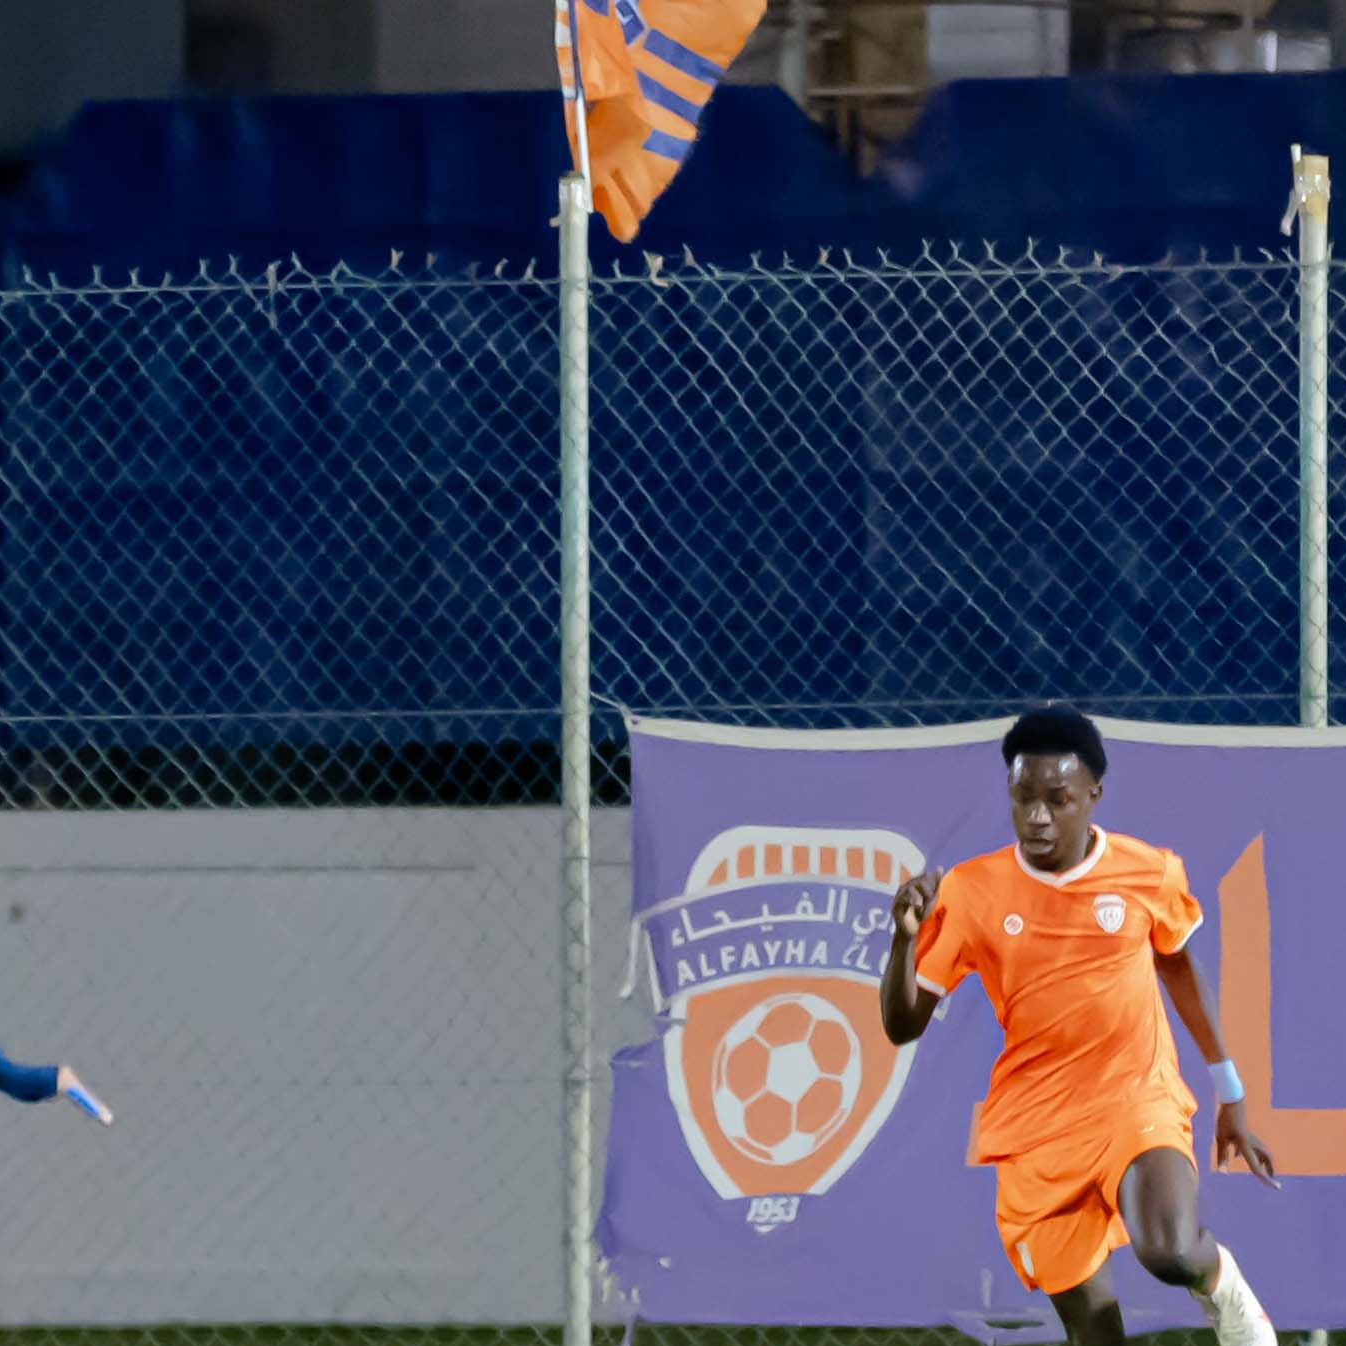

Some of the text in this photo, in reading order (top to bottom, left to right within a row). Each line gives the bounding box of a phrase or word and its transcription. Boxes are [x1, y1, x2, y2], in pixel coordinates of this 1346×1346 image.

[670, 888, 849, 947] الفيحاء
[676, 940, 891, 988] ALFAYHA CL
[746, 1197, 801, 1223] 1953
